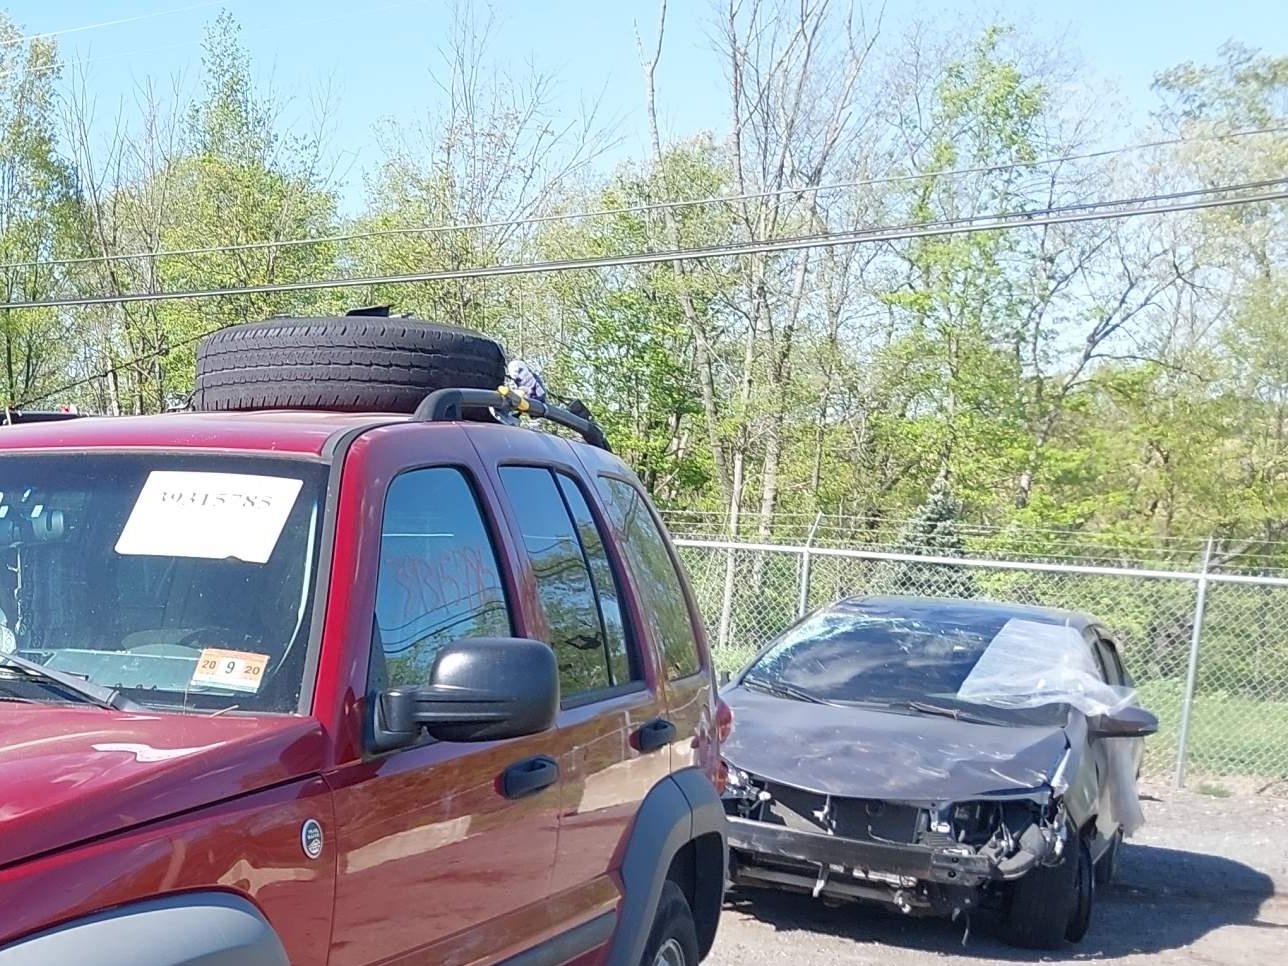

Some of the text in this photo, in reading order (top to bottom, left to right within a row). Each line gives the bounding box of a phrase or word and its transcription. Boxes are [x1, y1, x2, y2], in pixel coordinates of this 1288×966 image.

[202, 659, 261, 676] 20 9 20
